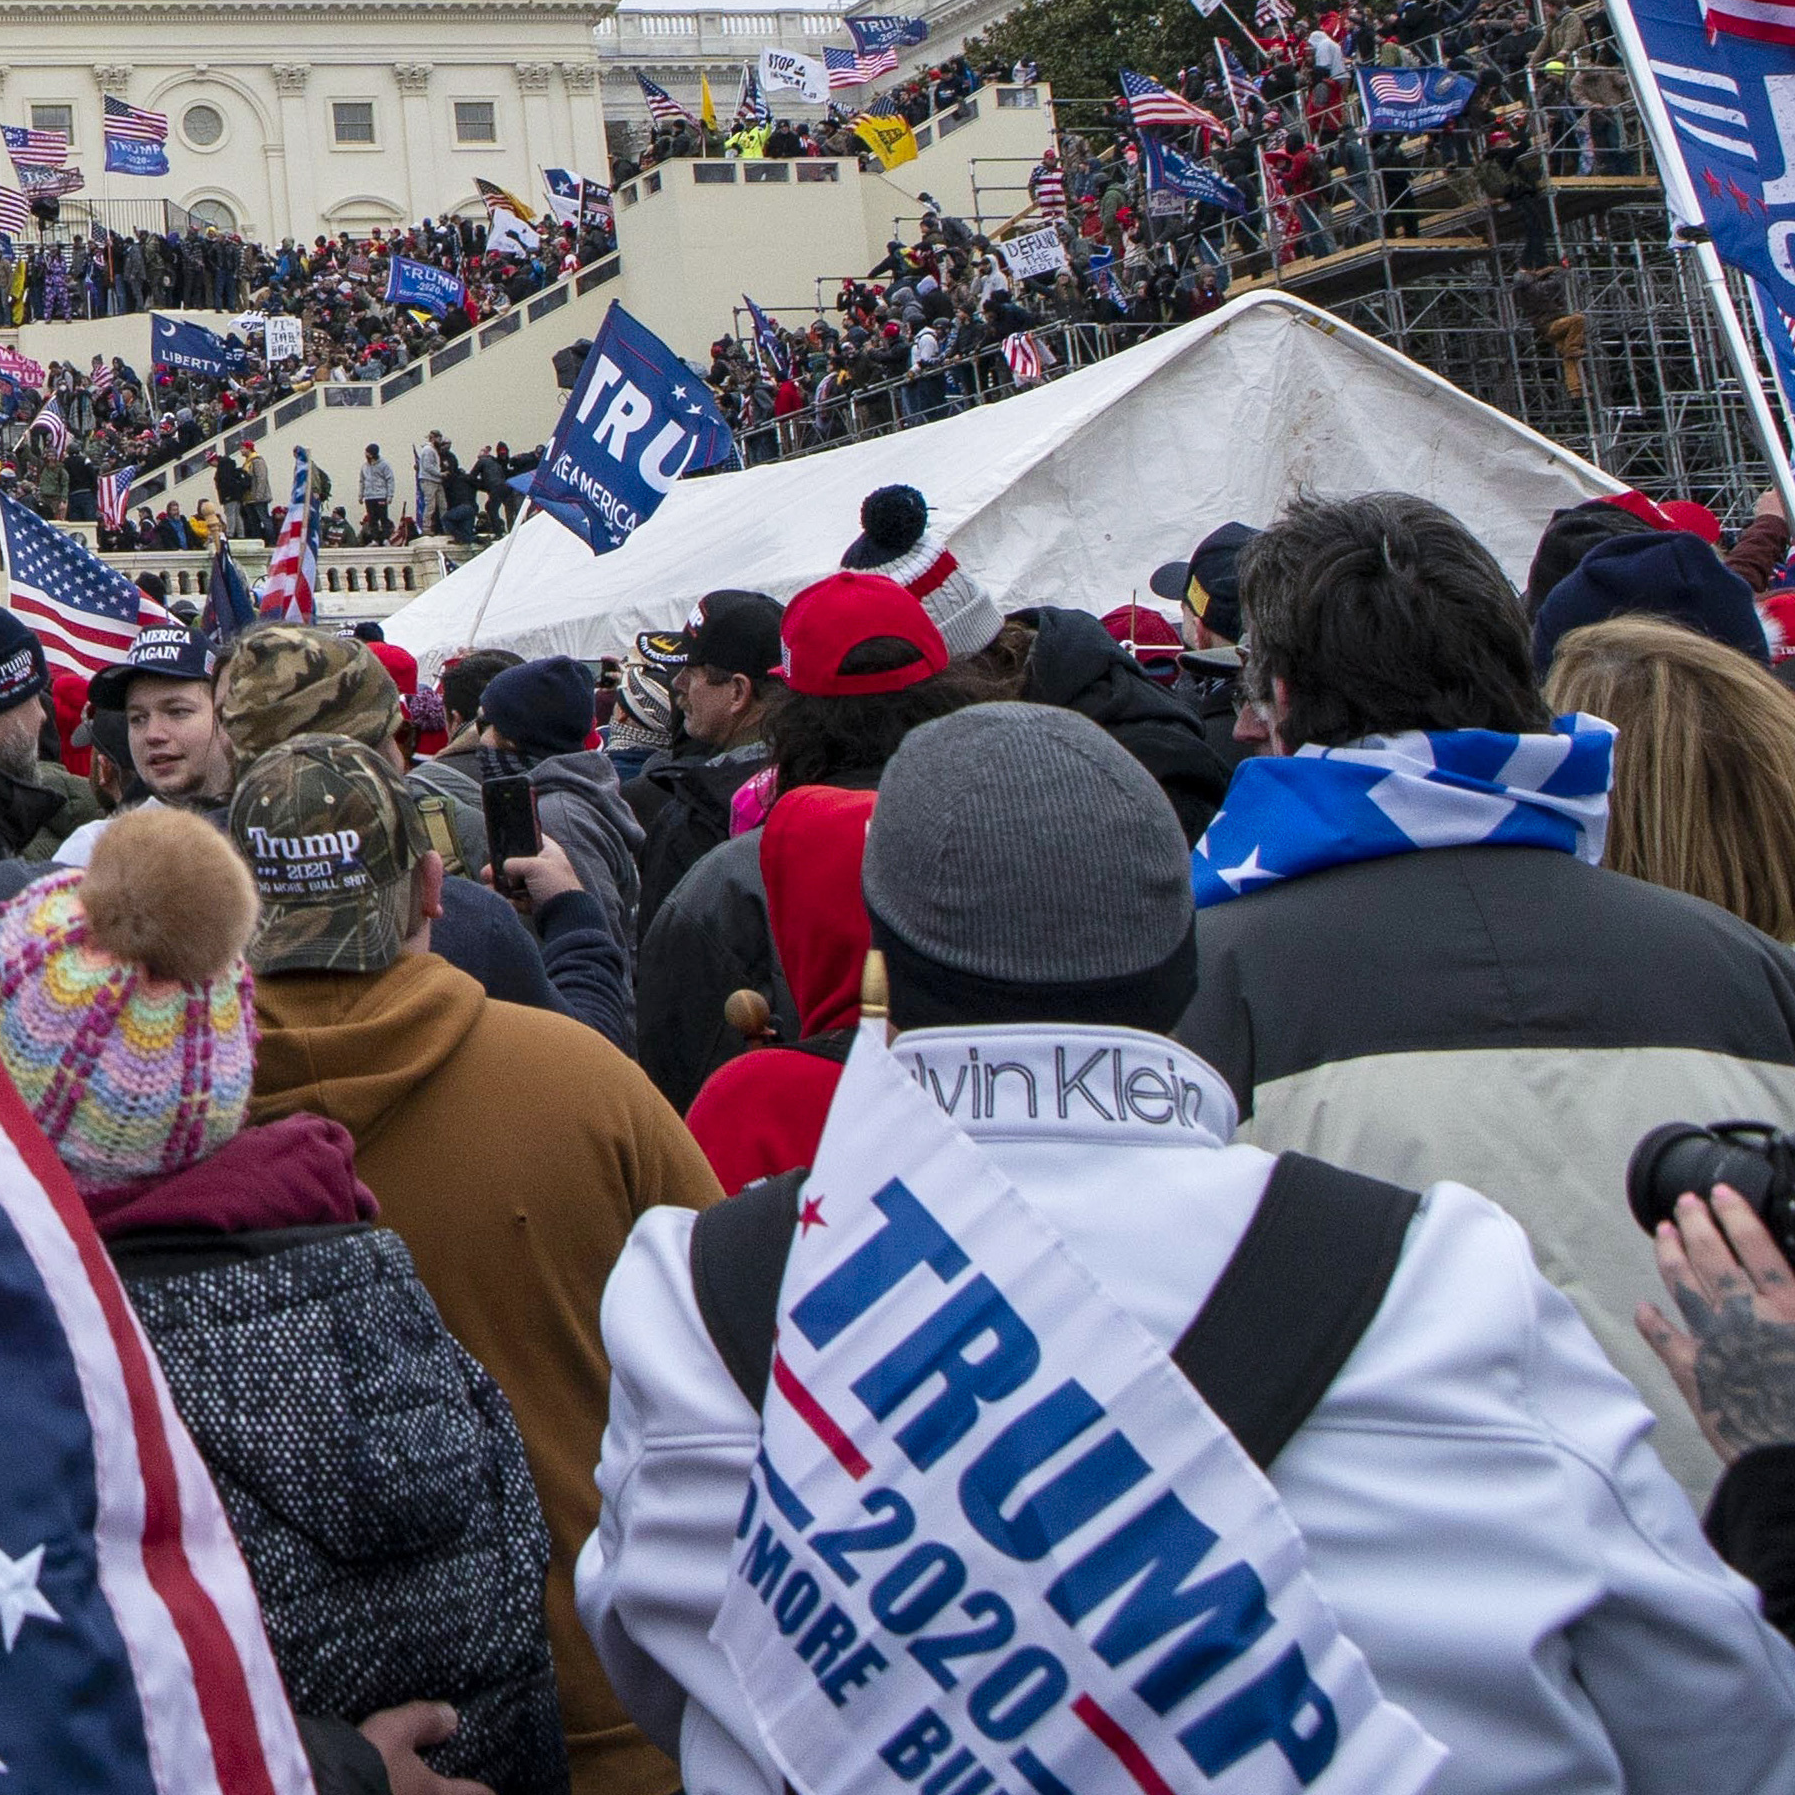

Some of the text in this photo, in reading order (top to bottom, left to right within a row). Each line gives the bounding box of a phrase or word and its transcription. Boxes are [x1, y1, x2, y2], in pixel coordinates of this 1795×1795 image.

[769, 53, 795, 71] STOP
[402, 264, 458, 292] TRUMP
[162, 350, 221, 373] LIBERTY
[578, 353, 699, 494] TRU
[570, 466, 636, 535] AMERICA
[135, 628, 191, 646] AMERICA
[137, 646, 180, 663] AGAIN
[248, 826, 360, 866] Trump
[273, 882, 305, 895] MORE
[310, 880, 339, 892] BULL
[343, 874, 367, 889] SHIT
[287, 862, 332, 880] 2020
[1056, 1046, 1202, 1130] Klein
[790, 1177, 1339, 1788] TRUMP
[737, 1521, 891, 1709] MORE
[811, 1483, 1070, 1746] 2020
